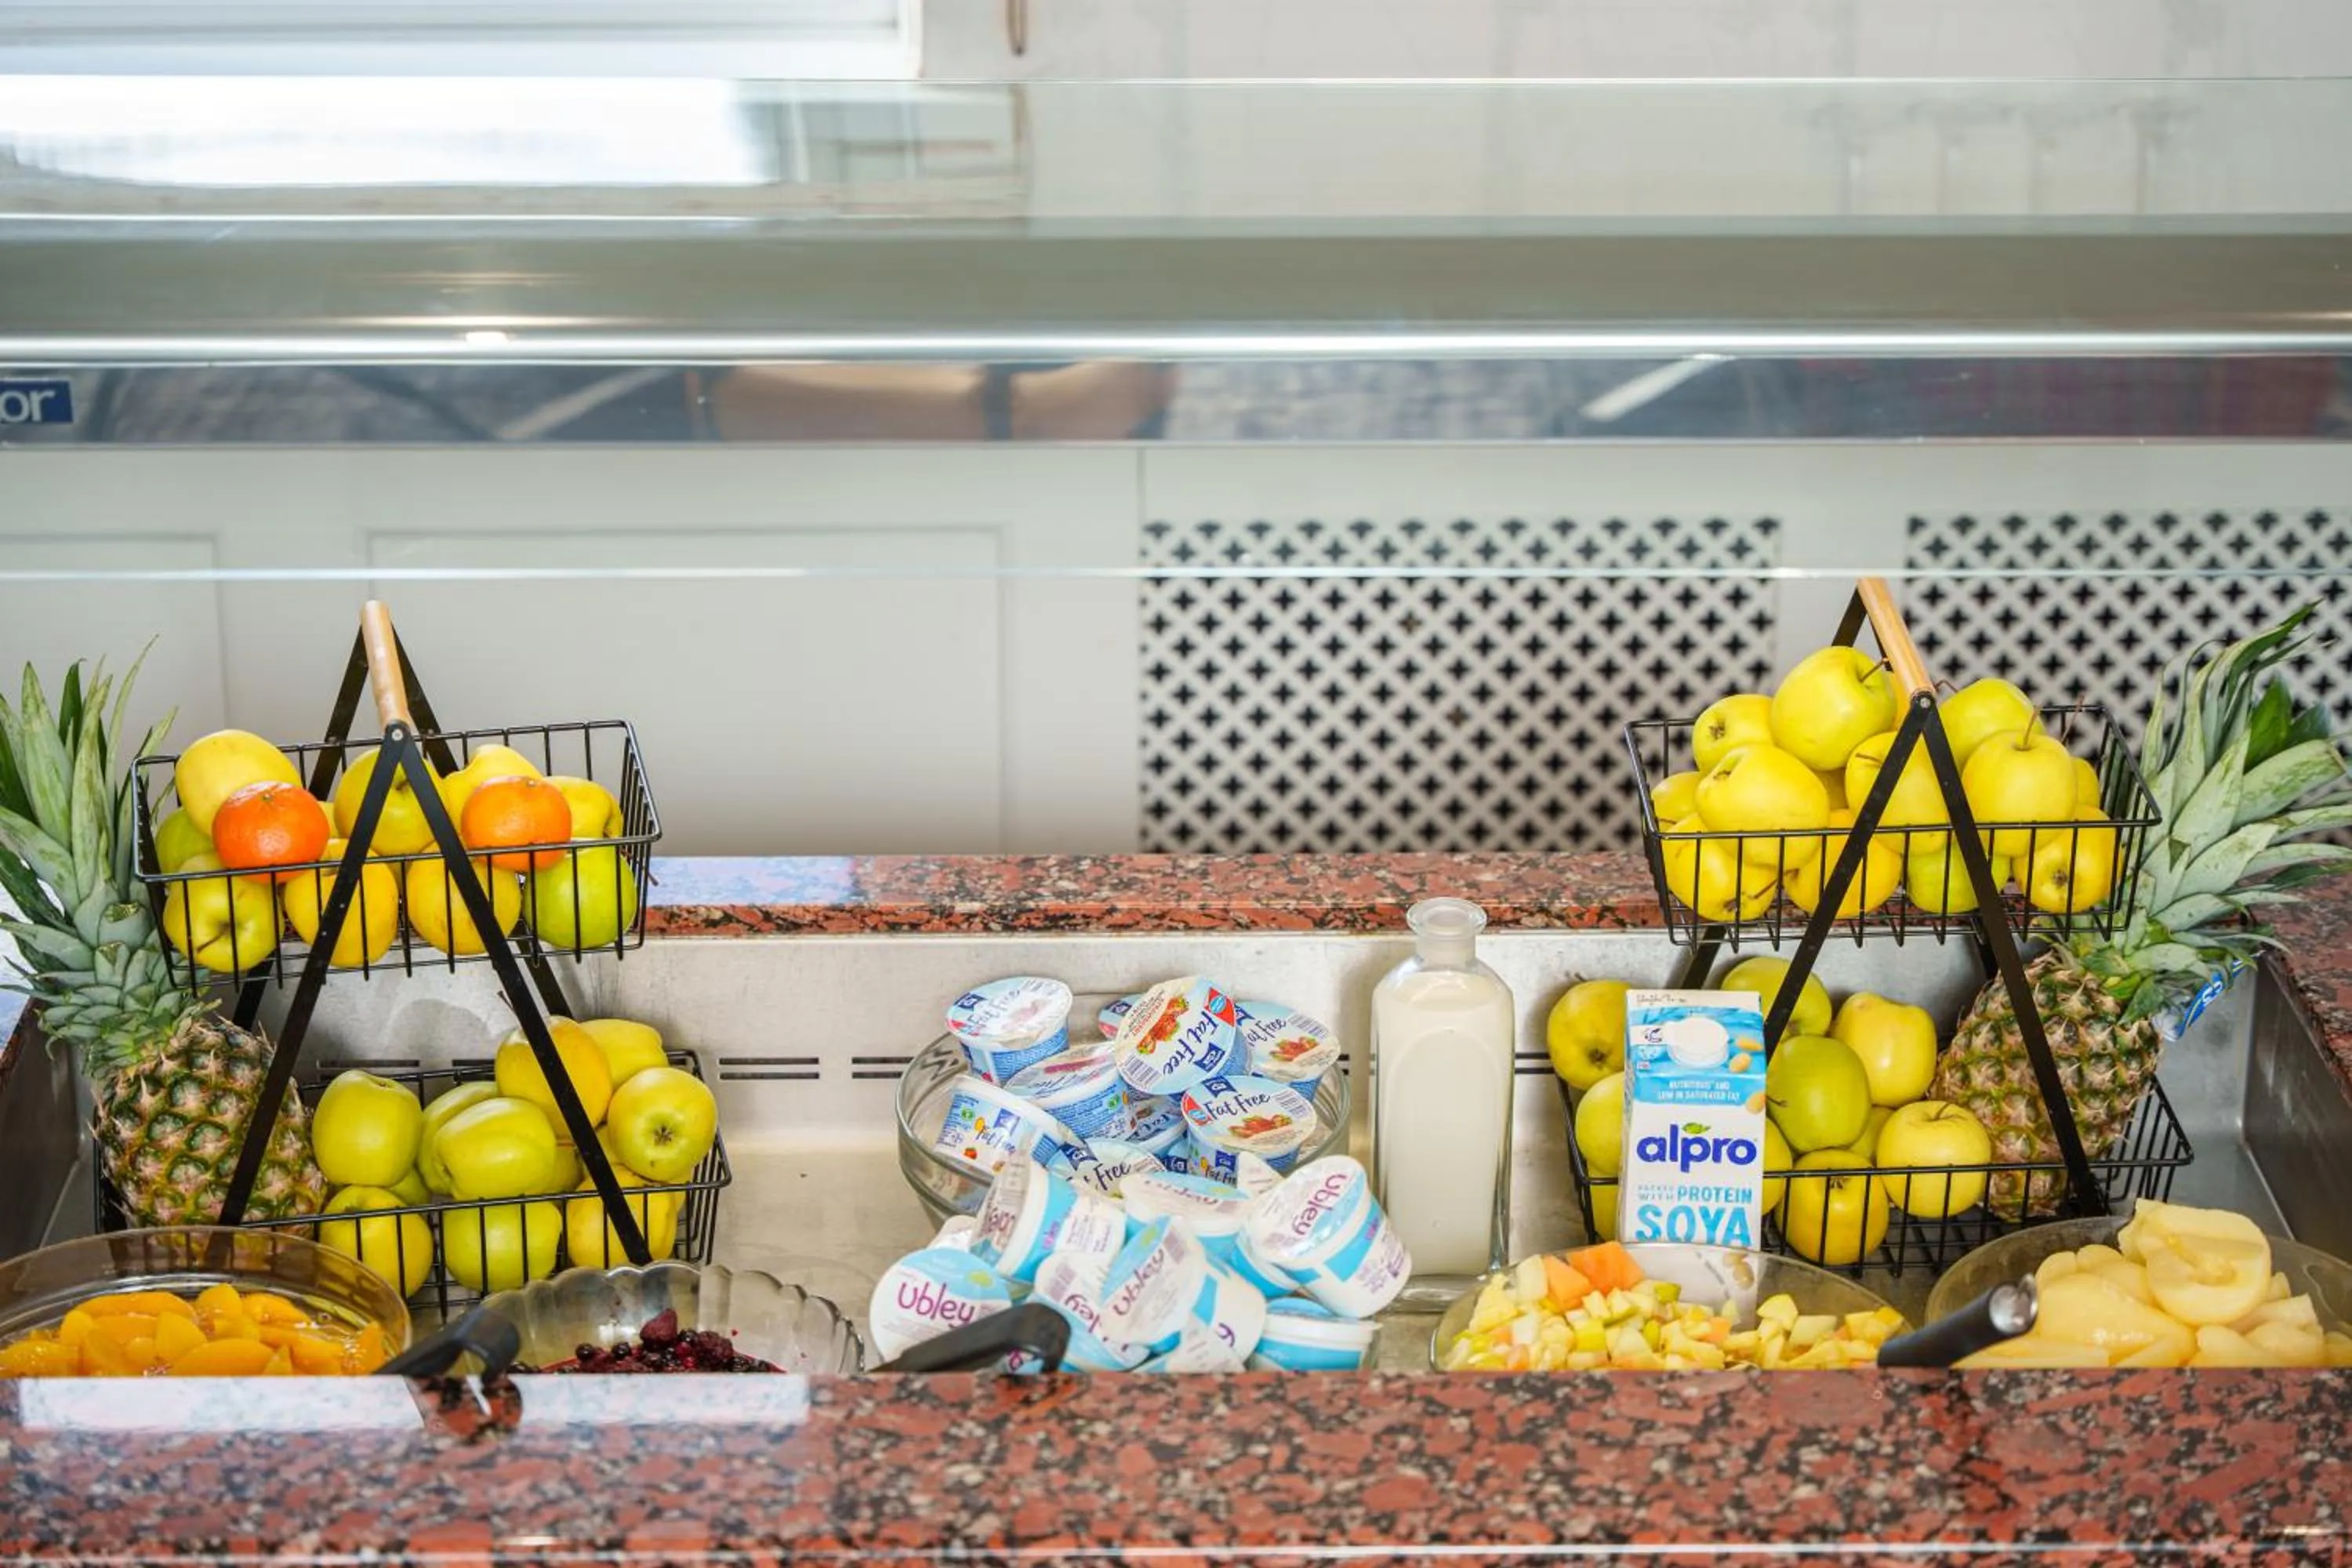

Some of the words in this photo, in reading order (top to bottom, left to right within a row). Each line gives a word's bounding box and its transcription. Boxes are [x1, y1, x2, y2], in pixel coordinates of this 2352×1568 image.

[1187, 1011, 1219, 1043] Fat
[1254, 1018, 1287, 1039] Free
[1163, 1038, 1196, 1075] Free
[1204, 1099, 1238, 1120] Fat
[1233, 1093, 1271, 1113] Free
[1636, 1123, 1757, 1173] alpro
[1093, 1162, 1131, 1190] Free
[1677, 1185, 1752, 1203] PROTEIN
[1635, 1203, 1751, 1247] SOYA
